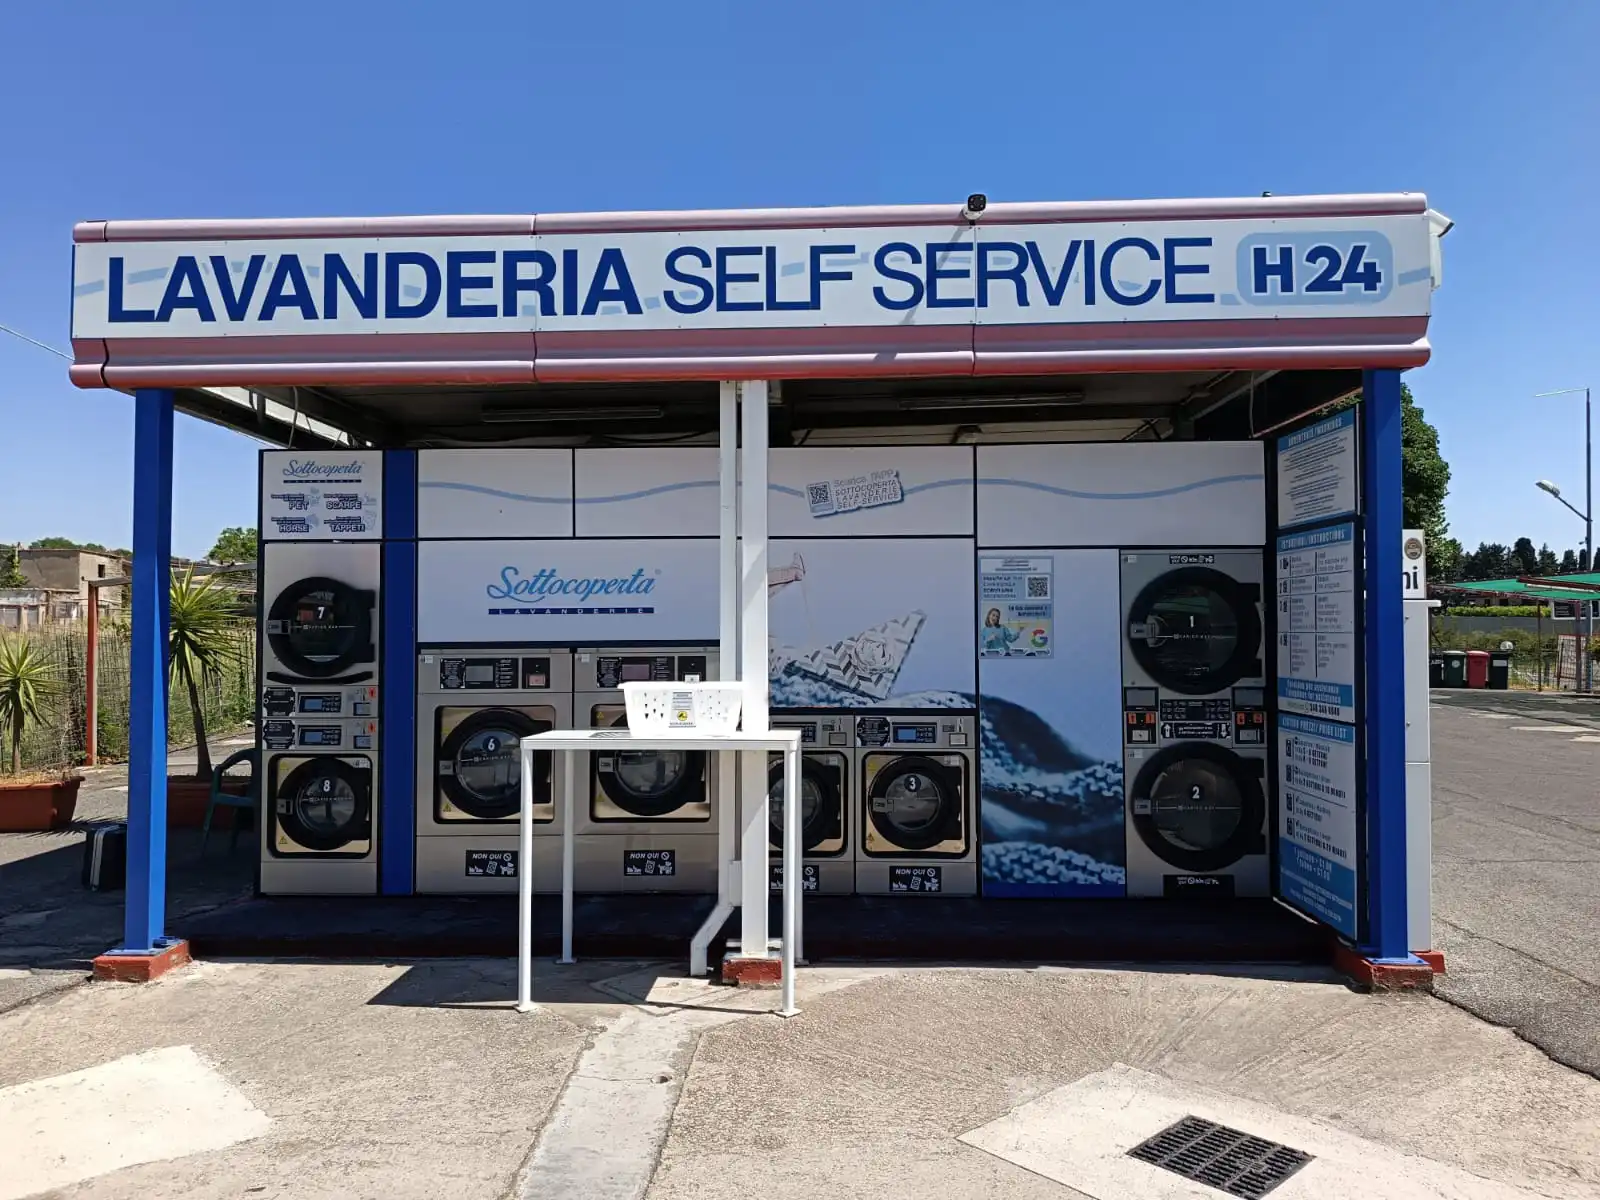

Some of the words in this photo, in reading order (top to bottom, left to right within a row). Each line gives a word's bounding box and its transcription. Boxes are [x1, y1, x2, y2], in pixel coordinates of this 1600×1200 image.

[108, 247, 643, 323] LAVANDERIA
[663, 245, 855, 314] SELF
[872, 236, 1215, 310] SERVICE
[1253, 247, 1293, 294] H
[1302, 243, 1382, 294] 24
[282, 459, 362, 477] Sottocoperta
[835, 480, 897, 497] SOTTOCOPERTA
[836, 486, 899, 503] LAVANDERIE
[862, 492, 899, 505] SERVICE
[288, 501, 310, 510] PET
[326, 501, 362, 510] SCARPE
[279, 524, 310, 533] HORSE
[330, 524, 366, 533] TAPPETI
[486, 566, 656, 603] Sottocoperta
[317, 606, 325, 620] 7
[1189, 615, 1194, 628] 1
[488, 738, 496, 751] 6
[323, 779, 331, 792] 8
[909, 777, 916, 790] 3
[1192, 786, 1200, 799] 2
[895, 868, 911, 876] NON
[912, 868, 926, 876] QUI
